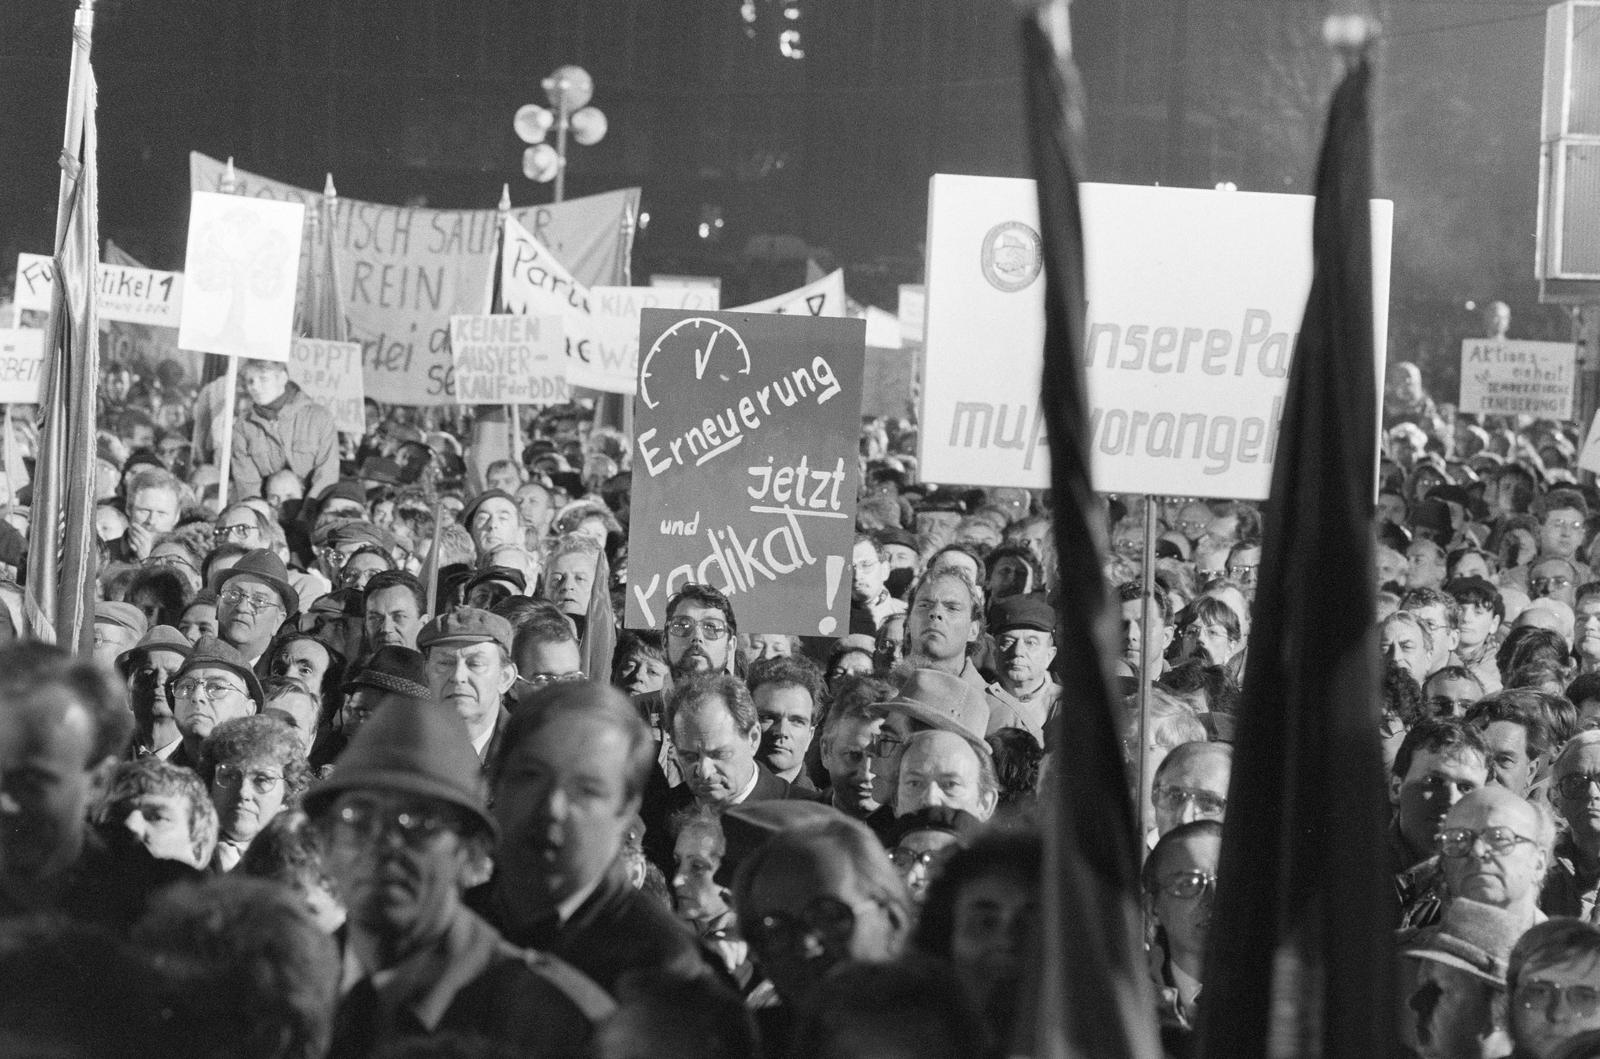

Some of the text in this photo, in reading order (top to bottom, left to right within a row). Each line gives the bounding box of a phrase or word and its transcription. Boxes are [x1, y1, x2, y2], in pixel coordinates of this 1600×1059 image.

[160, 275, 174, 302] 1
[351, 261, 445, 312] REIN
[455, 316, 540, 342] KEINEN
[1085, 308, 1296, 380] nsere Pa
[456, 345, 548, 375] AUSVER-
[458, 374, 568, 400] KAUF der DDR
[638, 356, 842, 477] Erneuerung
[661, 512, 699, 536] und
